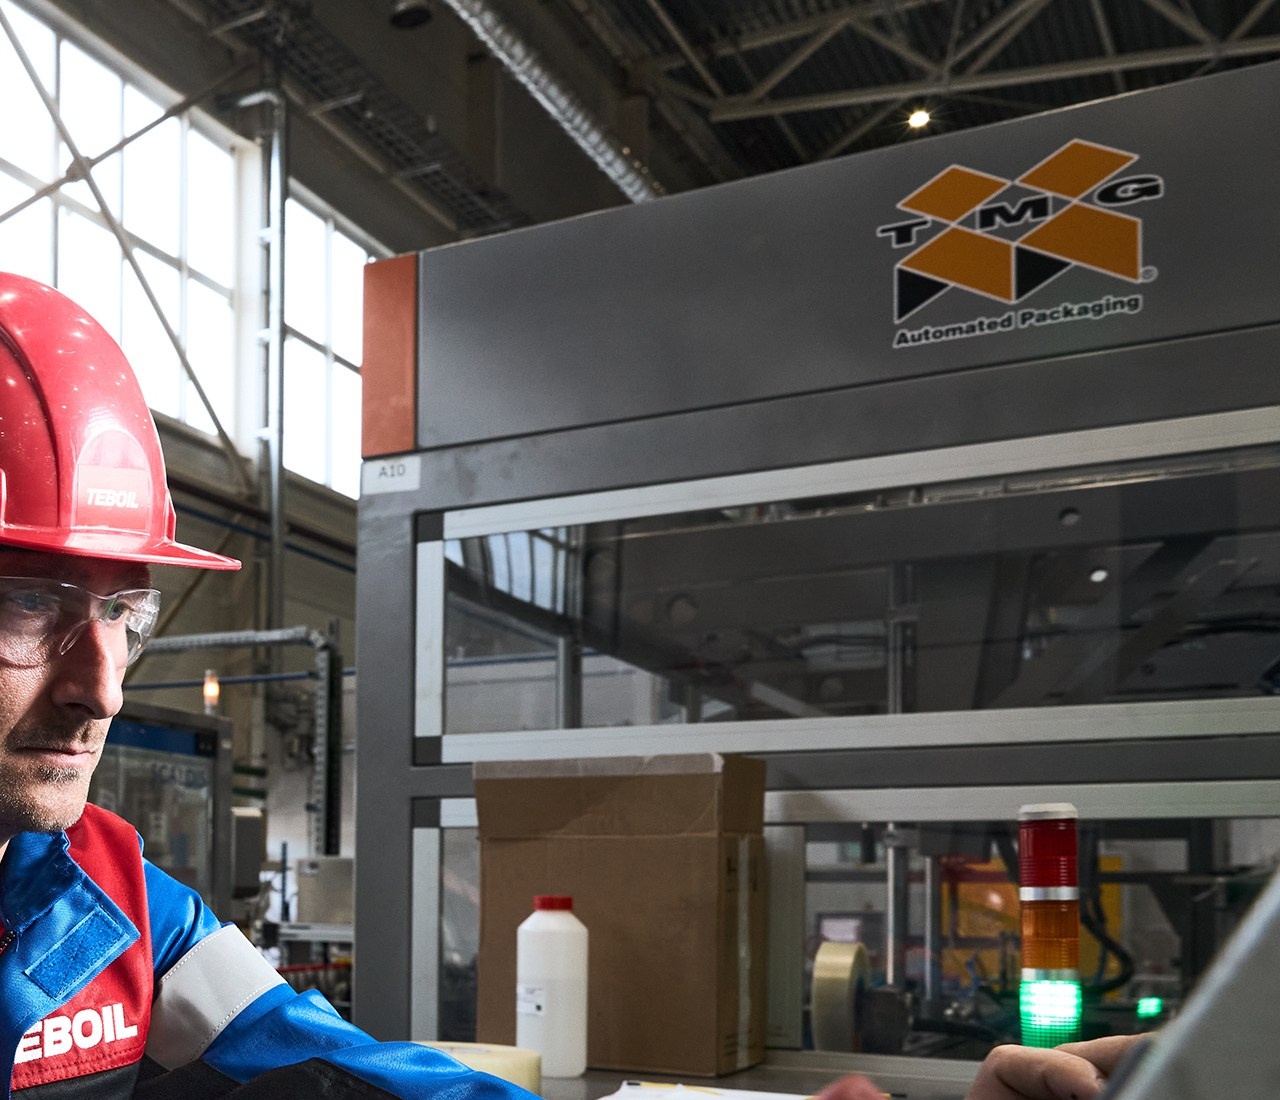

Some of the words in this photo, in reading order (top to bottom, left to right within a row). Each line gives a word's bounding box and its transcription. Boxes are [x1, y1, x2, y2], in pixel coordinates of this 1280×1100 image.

[877, 174, 1164, 248] TMG
[893, 311, 1013, 348] Automated
[1018, 294, 1143, 327] Packaging
[86, 487, 139, 509] TEBOIL
[14, 1002, 138, 1065] EBOIL
